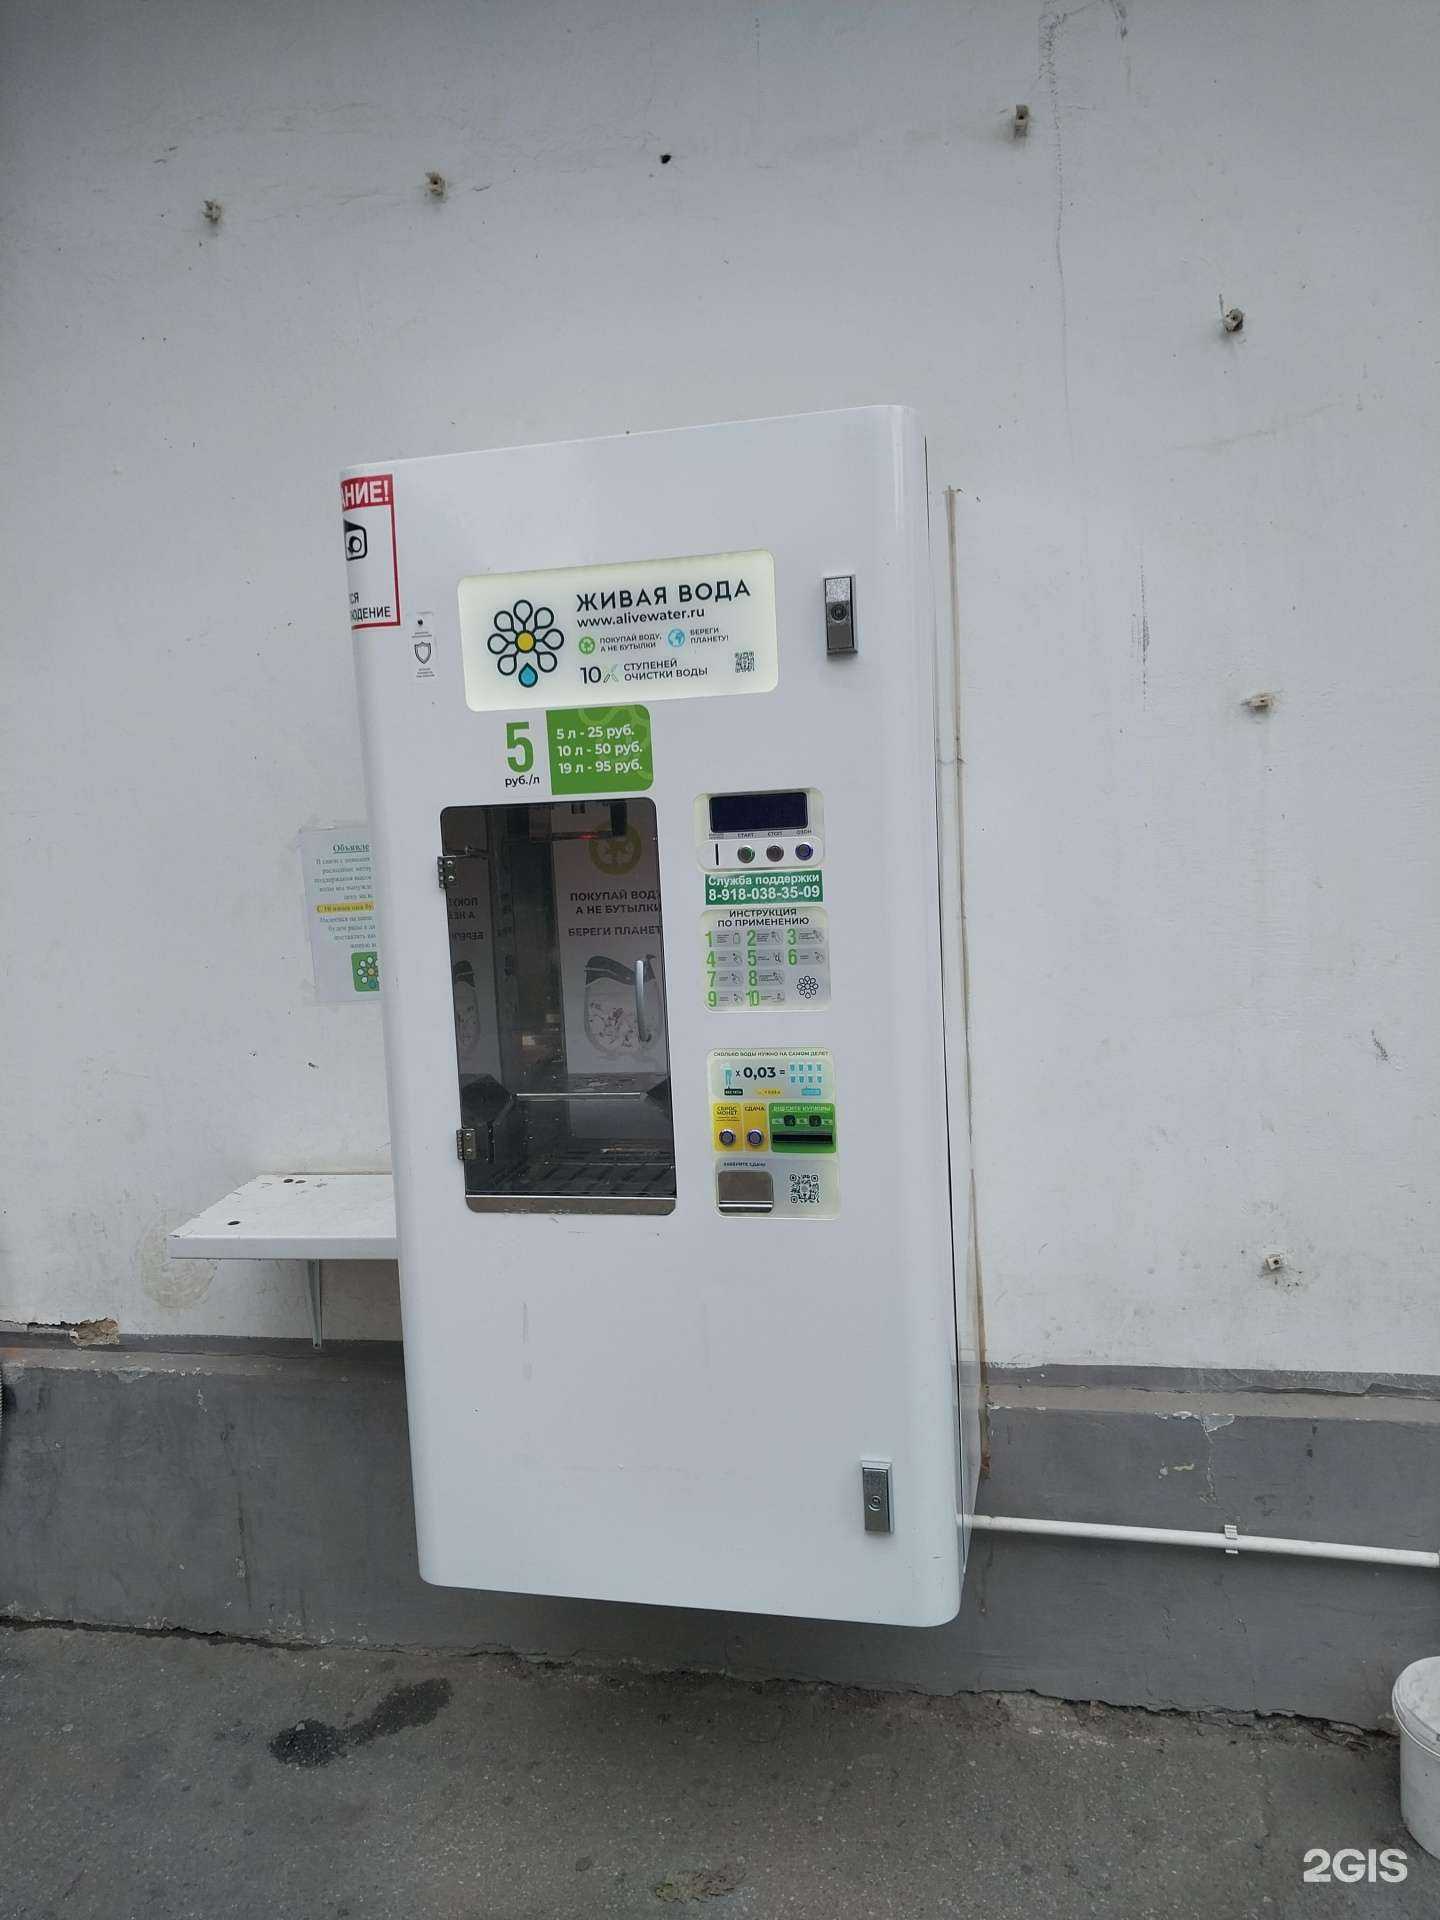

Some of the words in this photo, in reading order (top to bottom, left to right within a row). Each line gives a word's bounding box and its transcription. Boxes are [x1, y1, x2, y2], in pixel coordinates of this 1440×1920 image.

[576, 586, 667, 612] ЖИВАЯ
[679, 579, 751, 602] ВОДА
[577, 608, 705, 628] www.alivewater.ru
[600, 634, 637, 644] ПОКУПАЙ
[690, 627, 720, 636] БЕРЕГИ
[690, 635, 729, 644] ПЛАНЕТУ!
[619, 642, 656, 651] БУТЫЛКИ
[623, 658, 678, 672] СТУПЕНЕЙ
[624, 670, 673, 681] ОЧИСТКИ
[676, 667, 708, 678] ВОДЫ
[556, 728, 565, 740] 5
[567, 729, 576, 740] л
[587, 726, 604, 738] 25
[606, 724, 635, 739] руб.
[506, 722, 534, 773] 5
[558, 745, 571, 757] 10
[574, 746, 583, 756] л
[594, 743, 611, 755] 50
[614, 741, 643, 756] руб.
[558, 762, 572, 774] 19
[575, 765, 584, 774] л
[595, 761, 611, 773] 95
[614, 758, 643, 774] руб.
[505, 774, 540, 788] руб./л
[708, 875, 752, 888] Служба
[756, 873, 819, 886] поддержки
[570, 889, 627, 902] ПОКУПАЙ
[708, 885, 820, 901] 8-918-038-35-09
[576, 906, 583, 914] А
[587, 905, 602, 914] НЕ
[729, 908, 797, 917] ИНСТРУКЦИЯ
[717, 919, 732, 927] ПО
[735, 917, 810, 926] ПРИМЕНЕНИЮ
[568, 927, 611, 936] БЕРЕГИ
[705, 930, 713, 946] 1
[747, 929, 756, 946] 2
[787, 928, 796, 945] 3
[707, 951, 716, 967] 4
[747, 950, 756, 966] 5
[788, 949, 797, 965] 6
[707, 971, 716, 987] 7
[748, 970, 757, 986] 8
[708, 991, 717, 1007] 9
[746, 990, 760, 1006] 10
[743, 1067, 776, 1080] 0,03
